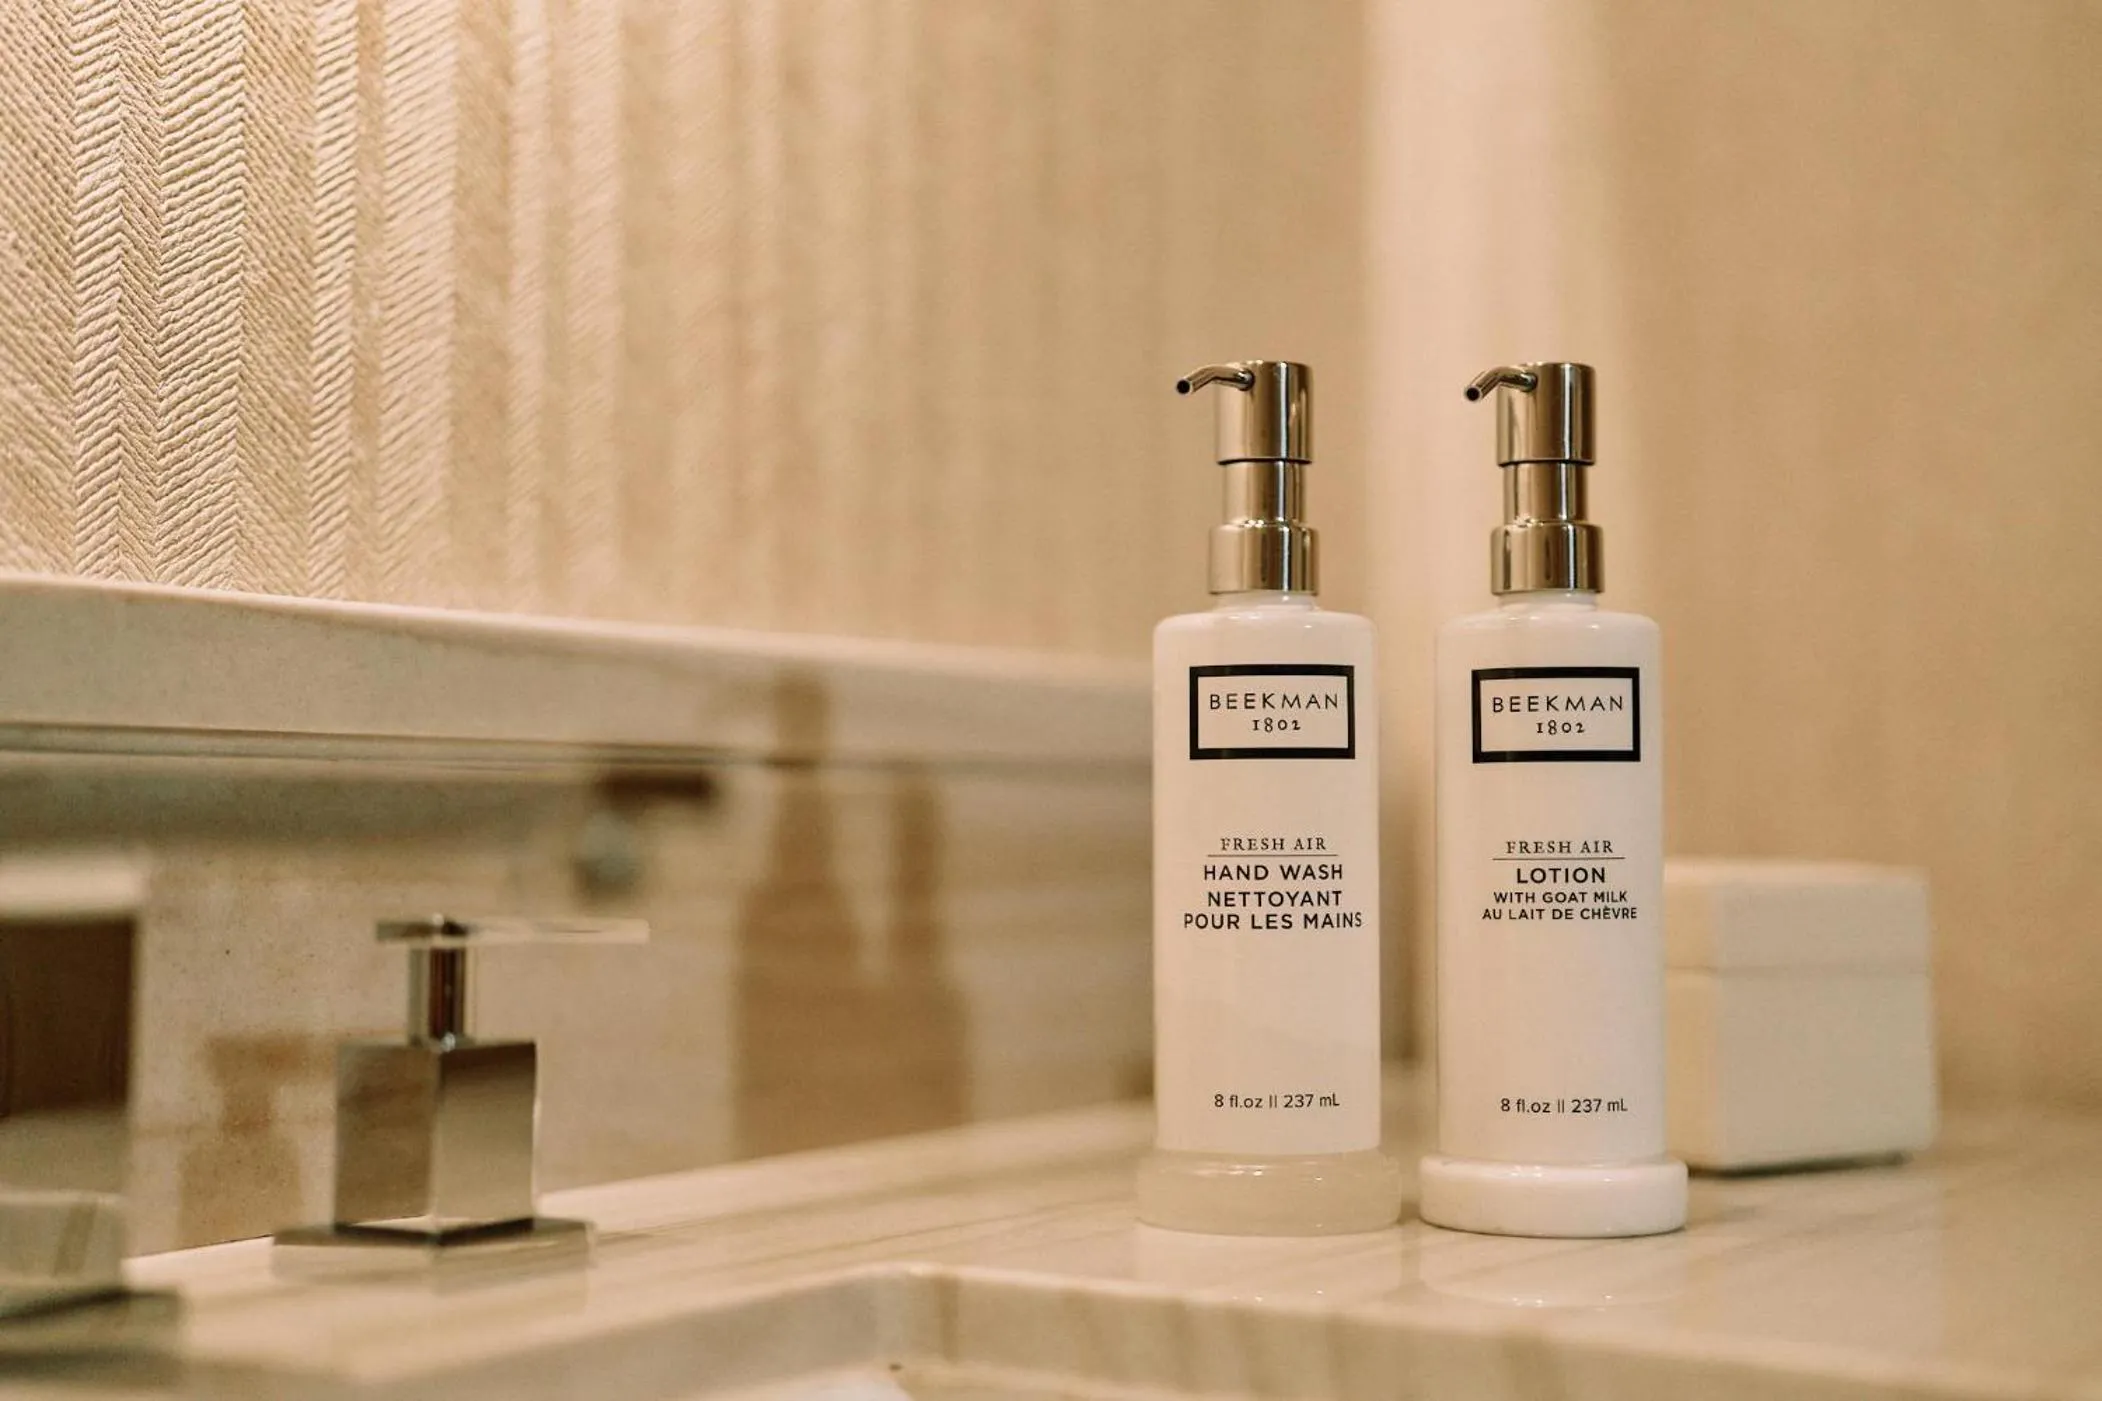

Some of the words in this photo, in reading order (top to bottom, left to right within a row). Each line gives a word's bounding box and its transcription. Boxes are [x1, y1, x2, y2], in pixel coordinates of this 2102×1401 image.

[1209, 692, 1338, 711] BEEKMAN
[1491, 695, 1624, 713] BEEKMAN
[1251, 717, 1302, 733] 1802
[1535, 719, 1586, 736] 1802
[1219, 837, 1286, 852] FRESH
[1292, 837, 1327, 852] AIR
[1505, 840, 1573, 855] FRESH
[1579, 840, 1614, 855] AIR
[1203, 864, 1269, 882] HAND
[1279, 863, 1344, 881] WASH
[1515, 866, 1606, 886] LOTION
[1206, 889, 1343, 908] NETTOYANT
[1492, 891, 1537, 905] WITH
[1541, 891, 1588, 905] GOAT
[1591, 890, 1629, 904] MILK
[1183, 912, 1241, 931] POUR
[1250, 912, 1294, 931] LES
[1302, 911, 1363, 930] MAINS
[1481, 907, 1504, 921] AU
[1508, 907, 1547, 921] LAIT
[1551, 907, 1575, 921] DE
[1579, 904, 1638, 921] CHÈVRE
[1214, 1093, 1225, 1109] 8
[1228, 1093, 1264, 1109] fl.oz
[1282, 1093, 1315, 1109] 237
[1318, 1091, 1341, 1108] mL
[1500, 1097, 1512, 1113] 8
[1514, 1097, 1553, 1114] fl.oz
[1570, 1097, 1603, 1114] 237
[1606, 1097, 1629, 1113] mL
